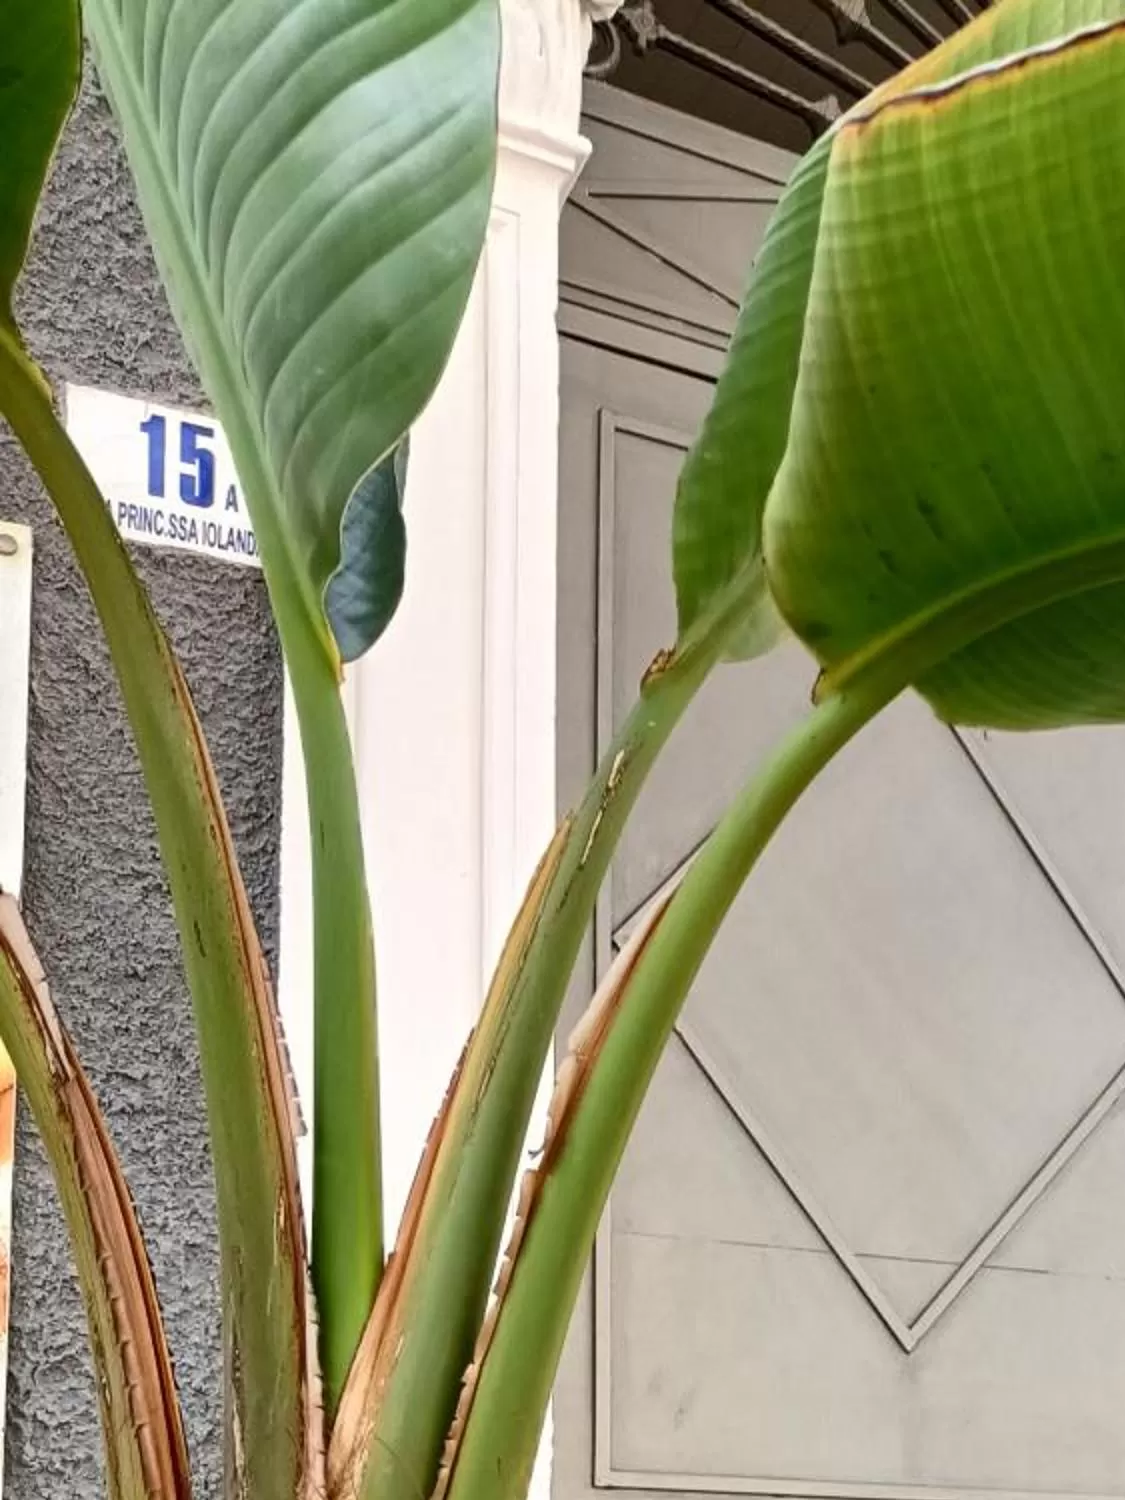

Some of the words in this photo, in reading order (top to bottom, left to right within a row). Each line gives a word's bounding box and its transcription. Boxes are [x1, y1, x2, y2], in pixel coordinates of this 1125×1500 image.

[140, 414, 215, 508] 15
[225, 484, 239, 512] A
[118, 502, 199, 545] PRINC.SSA
[202, 520, 259, 556] IOLAND
